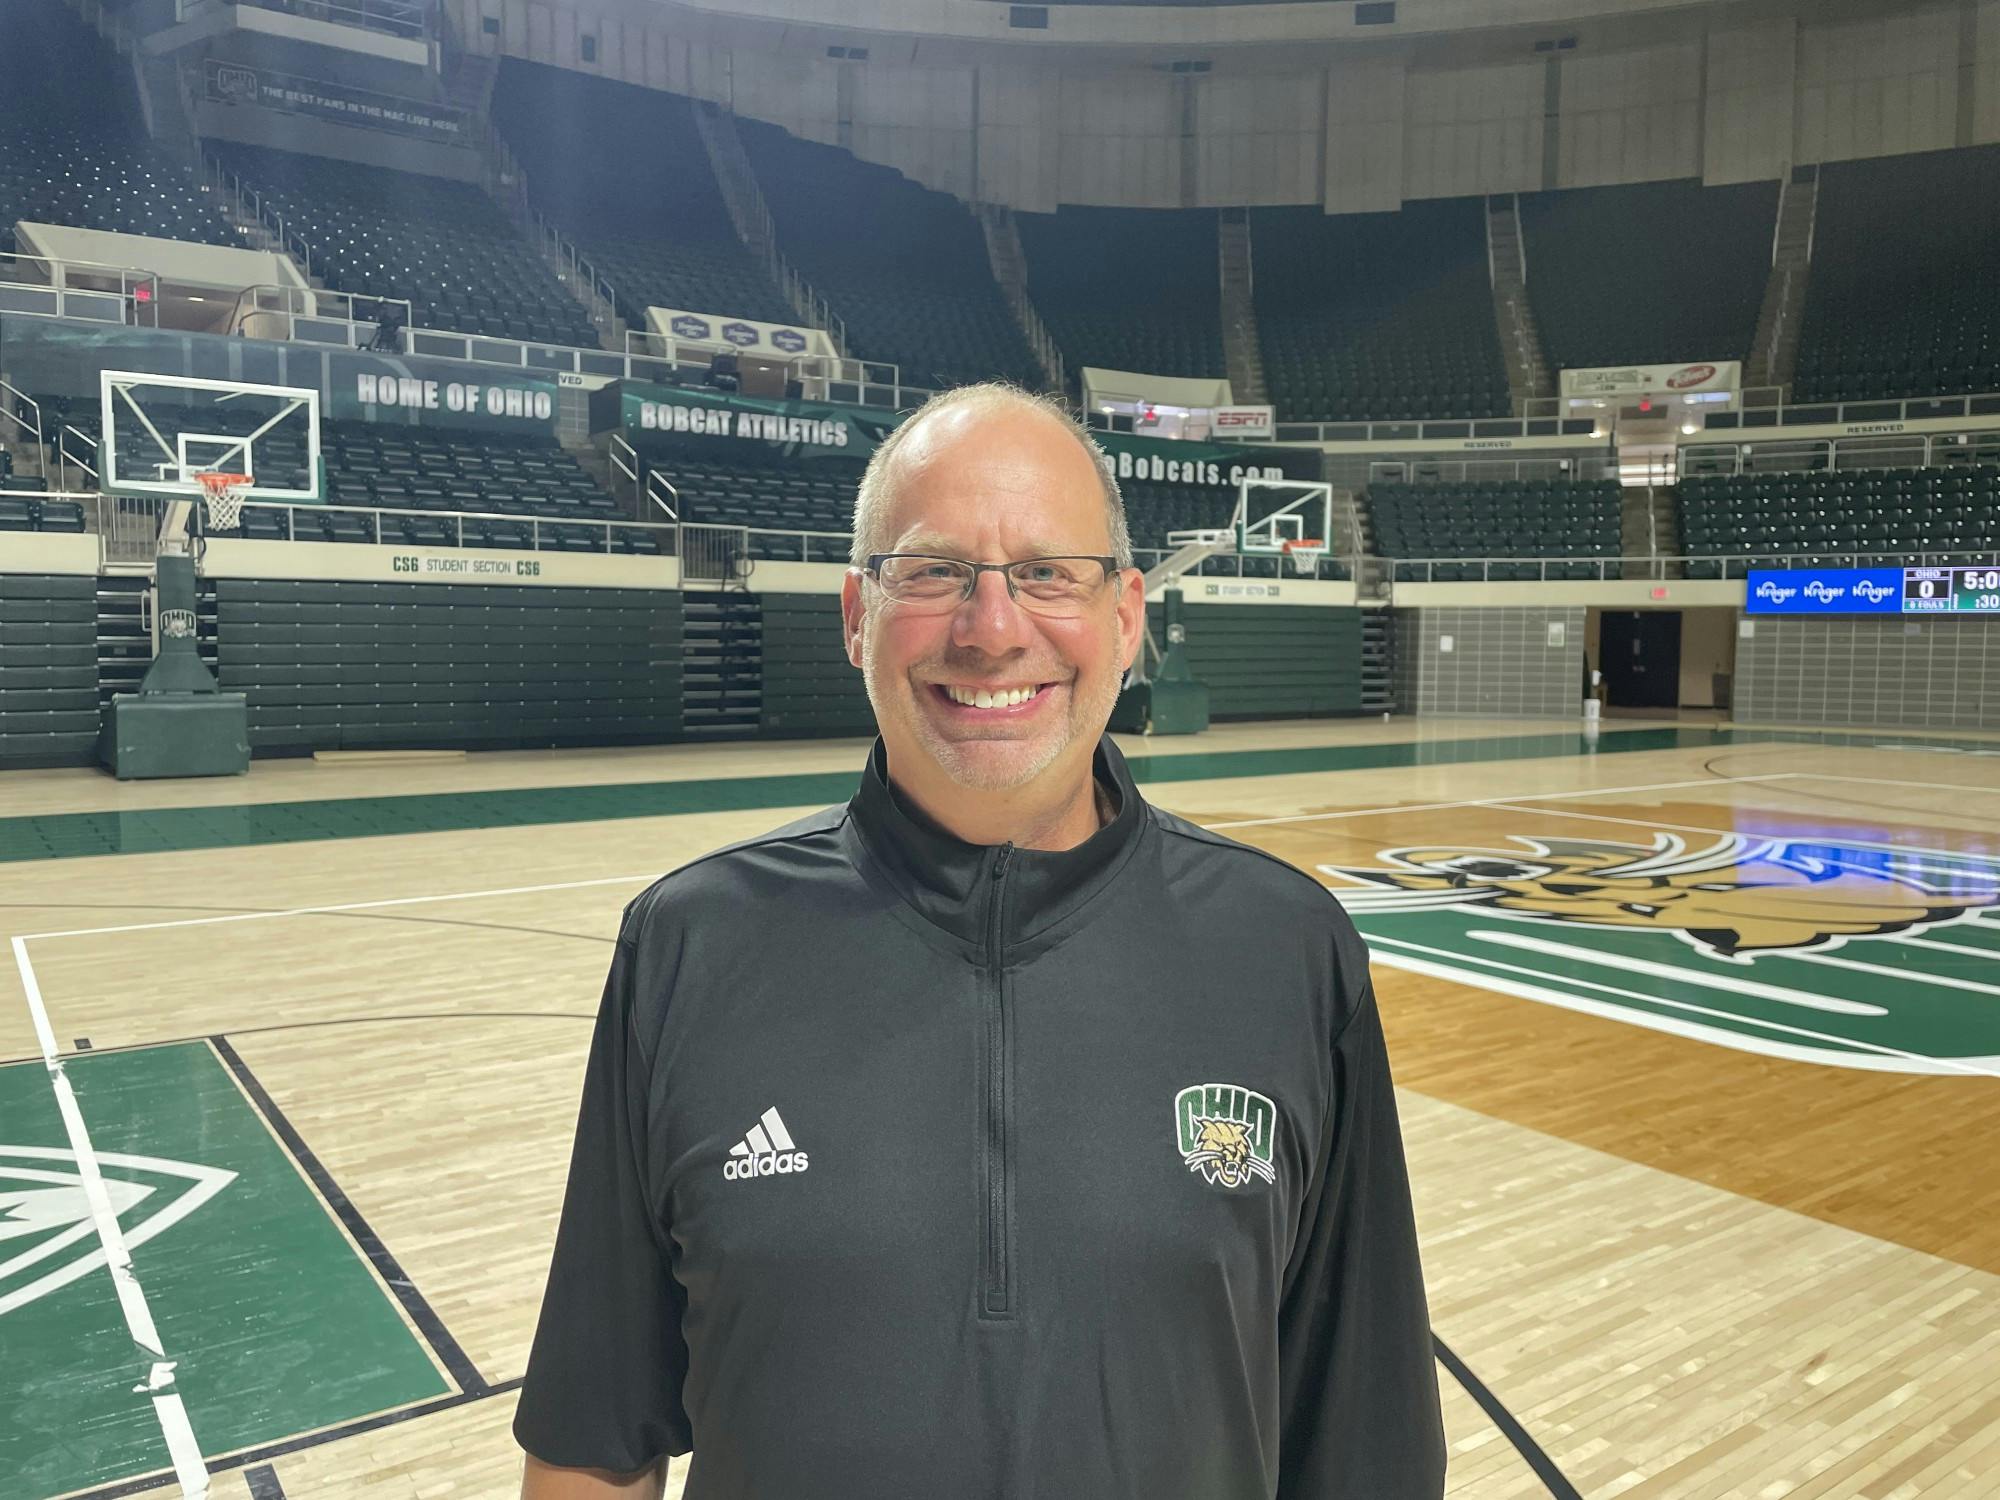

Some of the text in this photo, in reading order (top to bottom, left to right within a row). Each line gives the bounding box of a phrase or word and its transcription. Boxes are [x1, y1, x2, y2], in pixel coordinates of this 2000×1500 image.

[262, 86, 459, 132] THE BEST FANS IN THE MAC LIVE HERE
[358, 373, 551, 420] HOME OF OHIO
[640, 402, 848, 447] BOBCAT ATHLETICS
[1217, 412, 1268, 426] ESPN
[1847, 424, 1904, 434] RESERVED
[393, 556, 540, 576] CS6 STUDENT SECTION CS6
[1915, 569, 1941, 578] OHIO
[1919, 580, 1934, 598] 0
[1964, 571, 2000, 590] 5:0
[1756, 580, 1895, 604] Kroger Kroger Kroger
[723, 1149, 809, 1181] adidas
